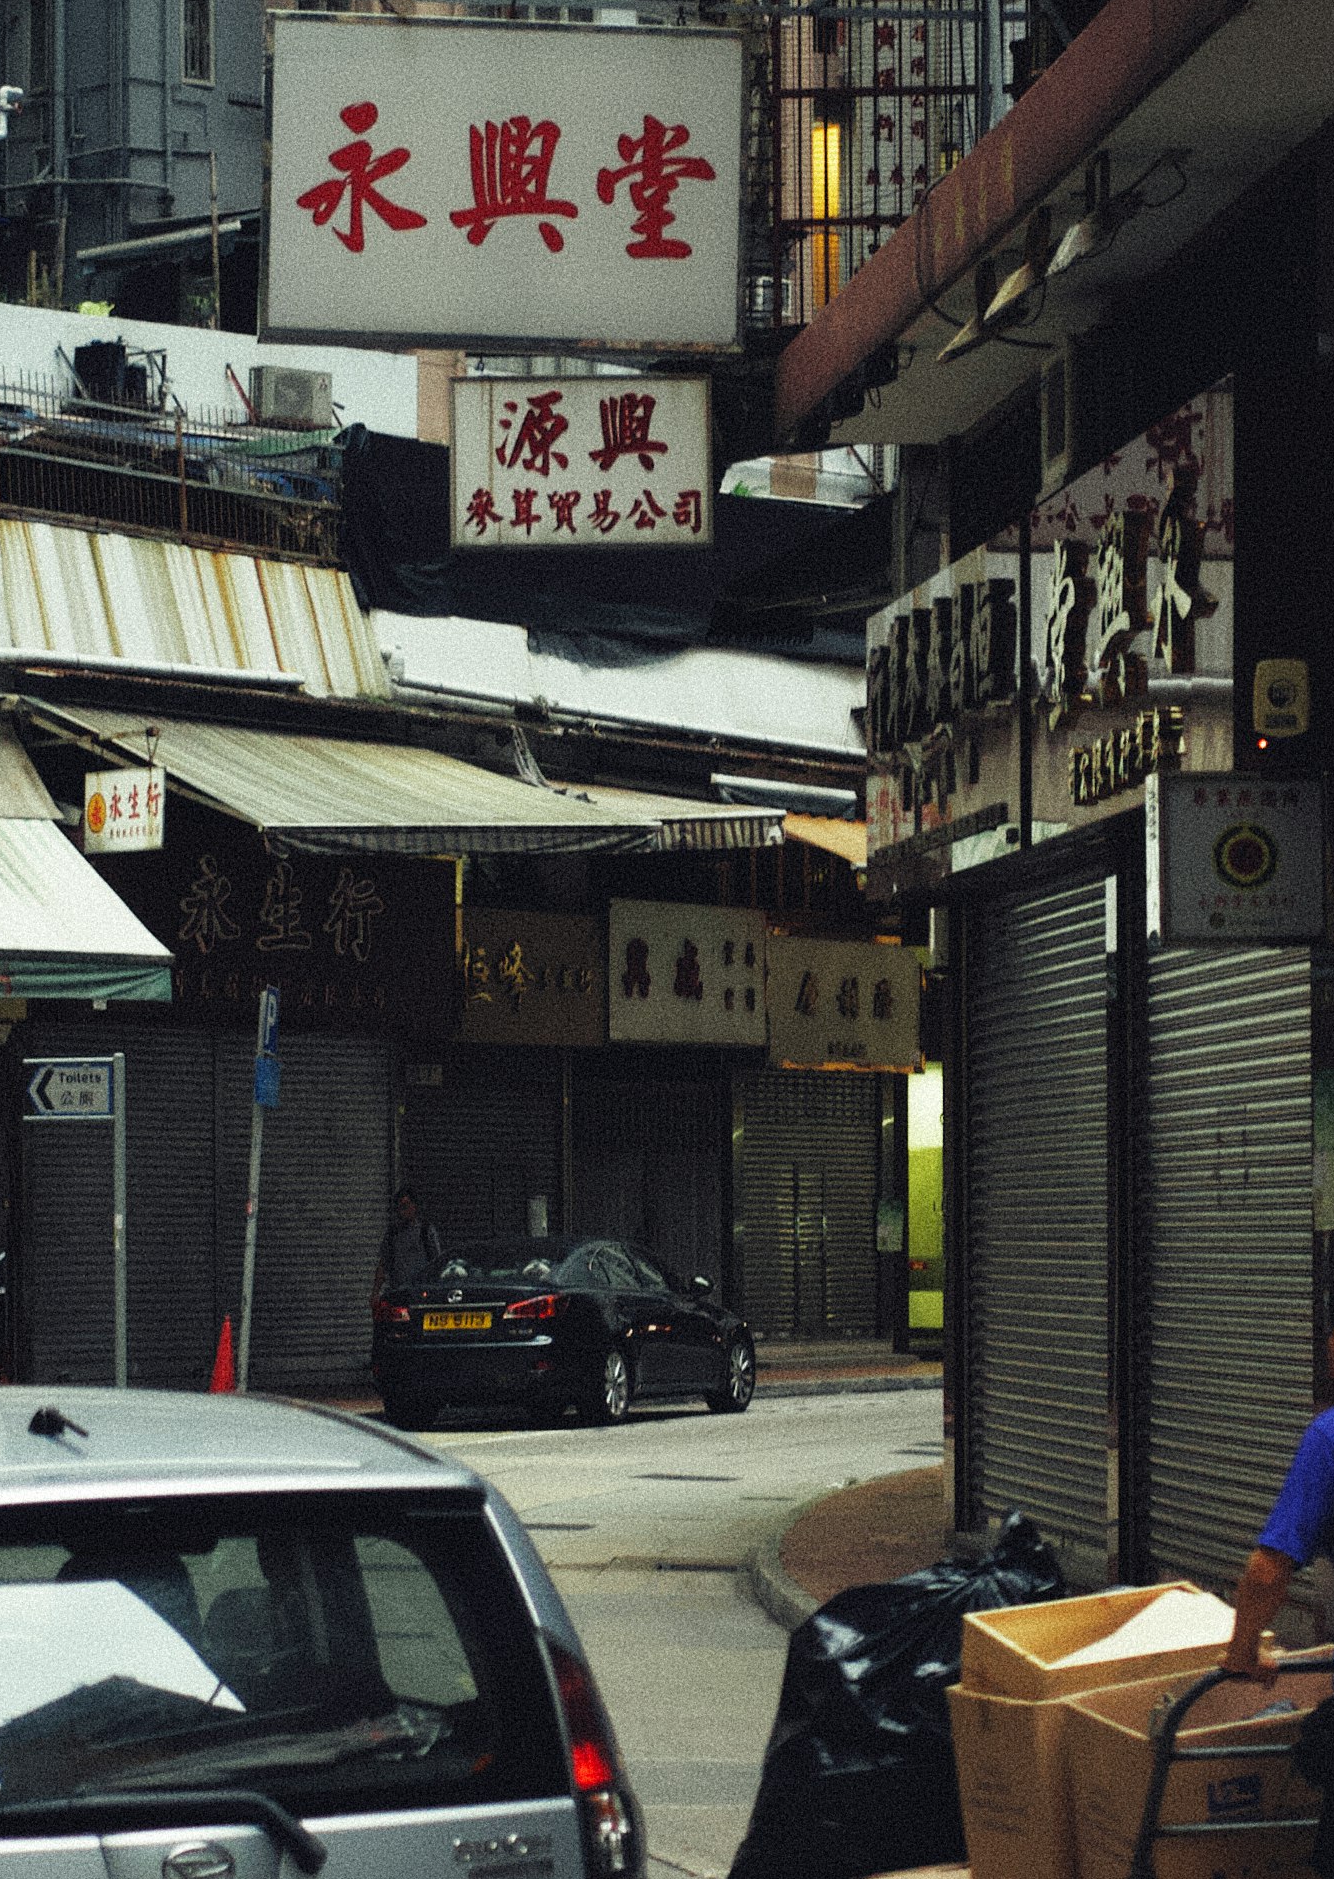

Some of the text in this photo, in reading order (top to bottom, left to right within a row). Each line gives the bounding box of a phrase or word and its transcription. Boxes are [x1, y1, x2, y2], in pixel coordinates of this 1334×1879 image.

[297, 101, 717, 260] 永興堂
[177, 853, 385, 963] 永生行
[59, 1072, 102, 1084] Toilets
